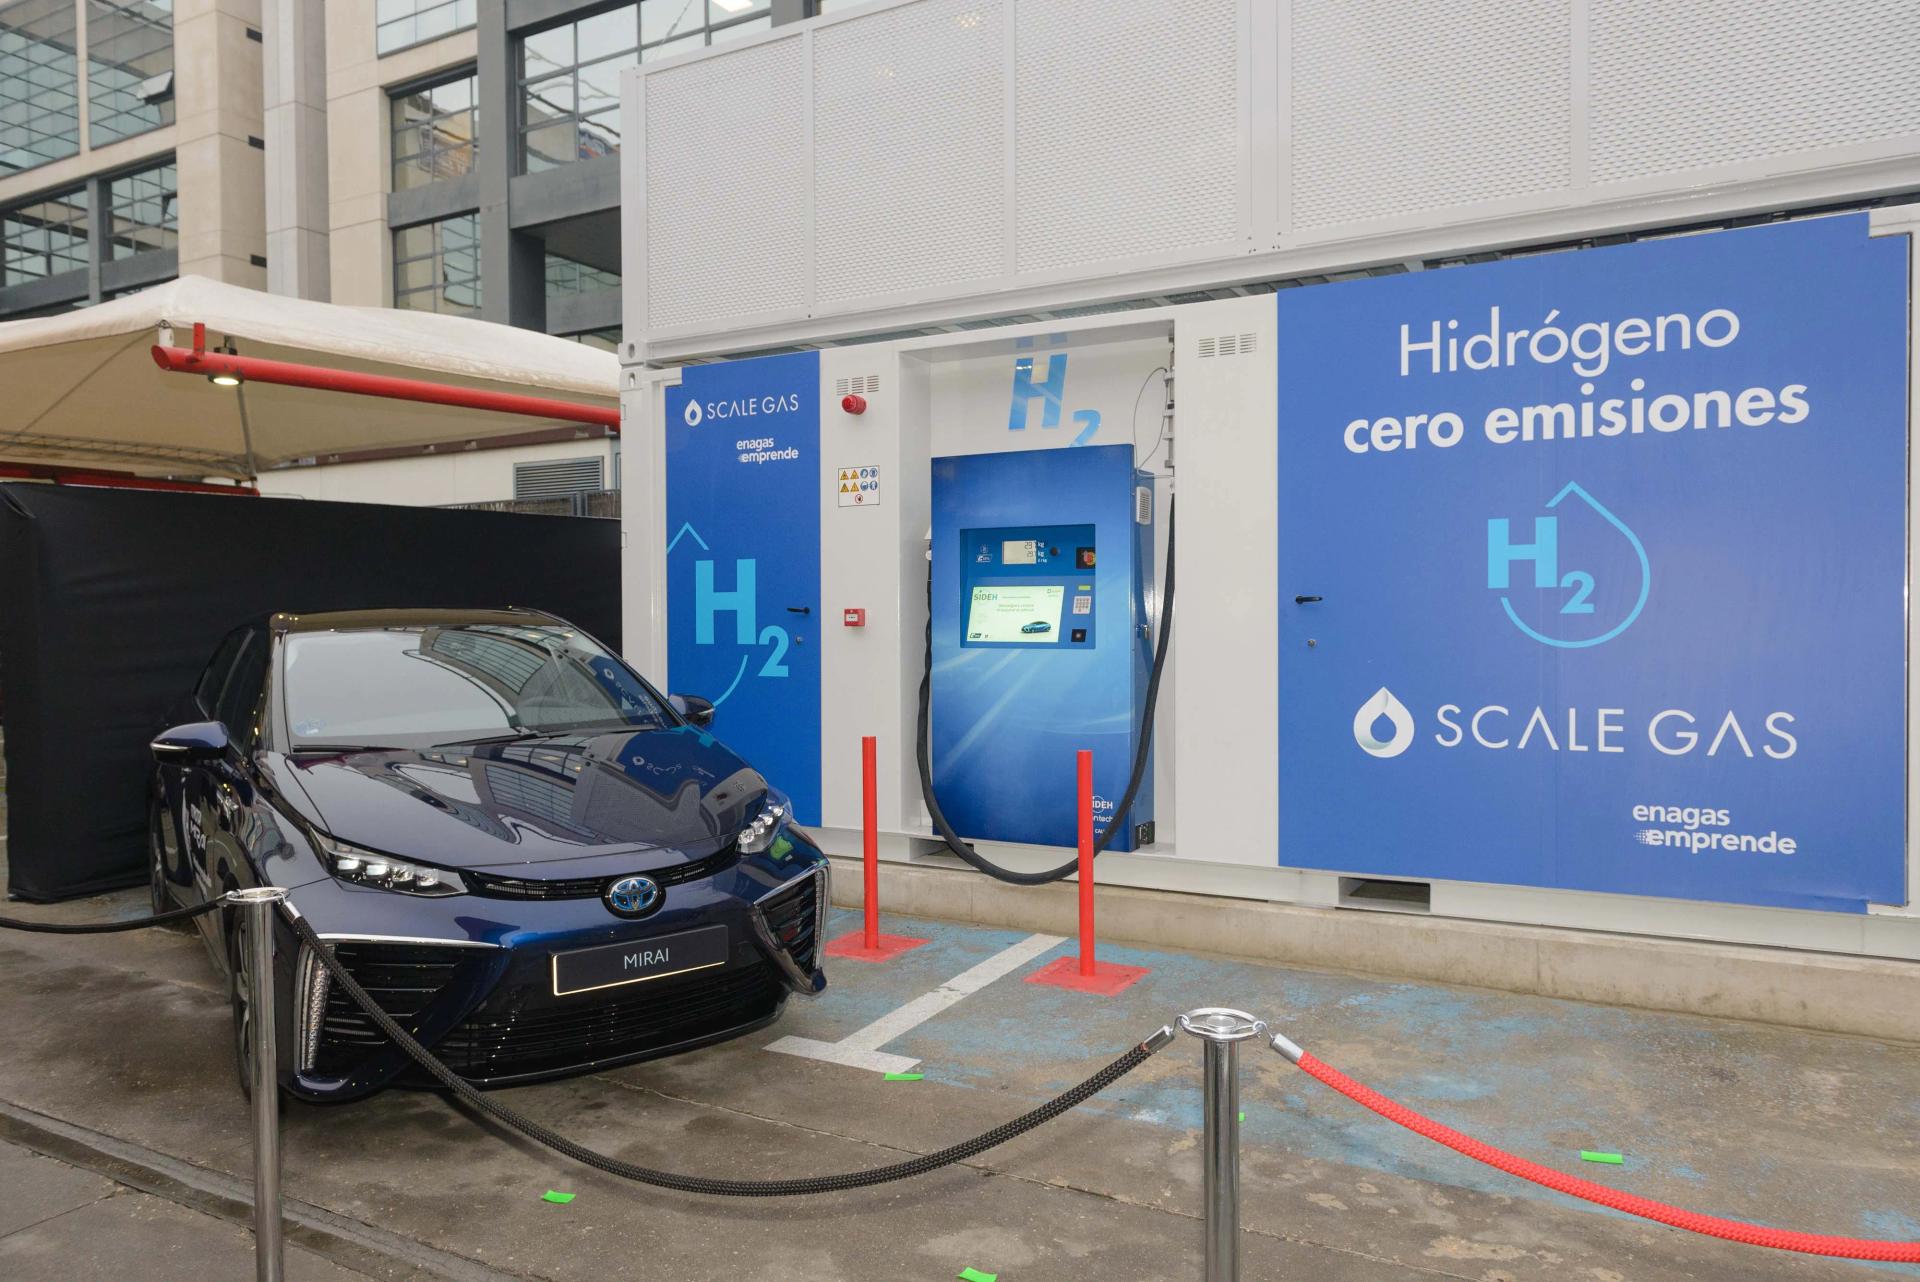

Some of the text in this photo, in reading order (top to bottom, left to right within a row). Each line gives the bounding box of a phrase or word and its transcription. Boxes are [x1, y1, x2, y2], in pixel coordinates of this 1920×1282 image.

[1399, 305, 1740, 377] Hidrógeno
[707, 393, 799, 420] SCALE GAS
[1343, 378, 1810, 453] cero emisiones
[736, 438, 774, 452] enagas
[741, 447, 799, 464] emprende
[1434, 704, 1798, 759] SCALE GAS
[1092, 796, 1114, 809] IDEH
[1632, 804, 1731, 829] enagas
[1648, 829, 1797, 856] emprende
[624, 947, 669, 970] MIRAI
